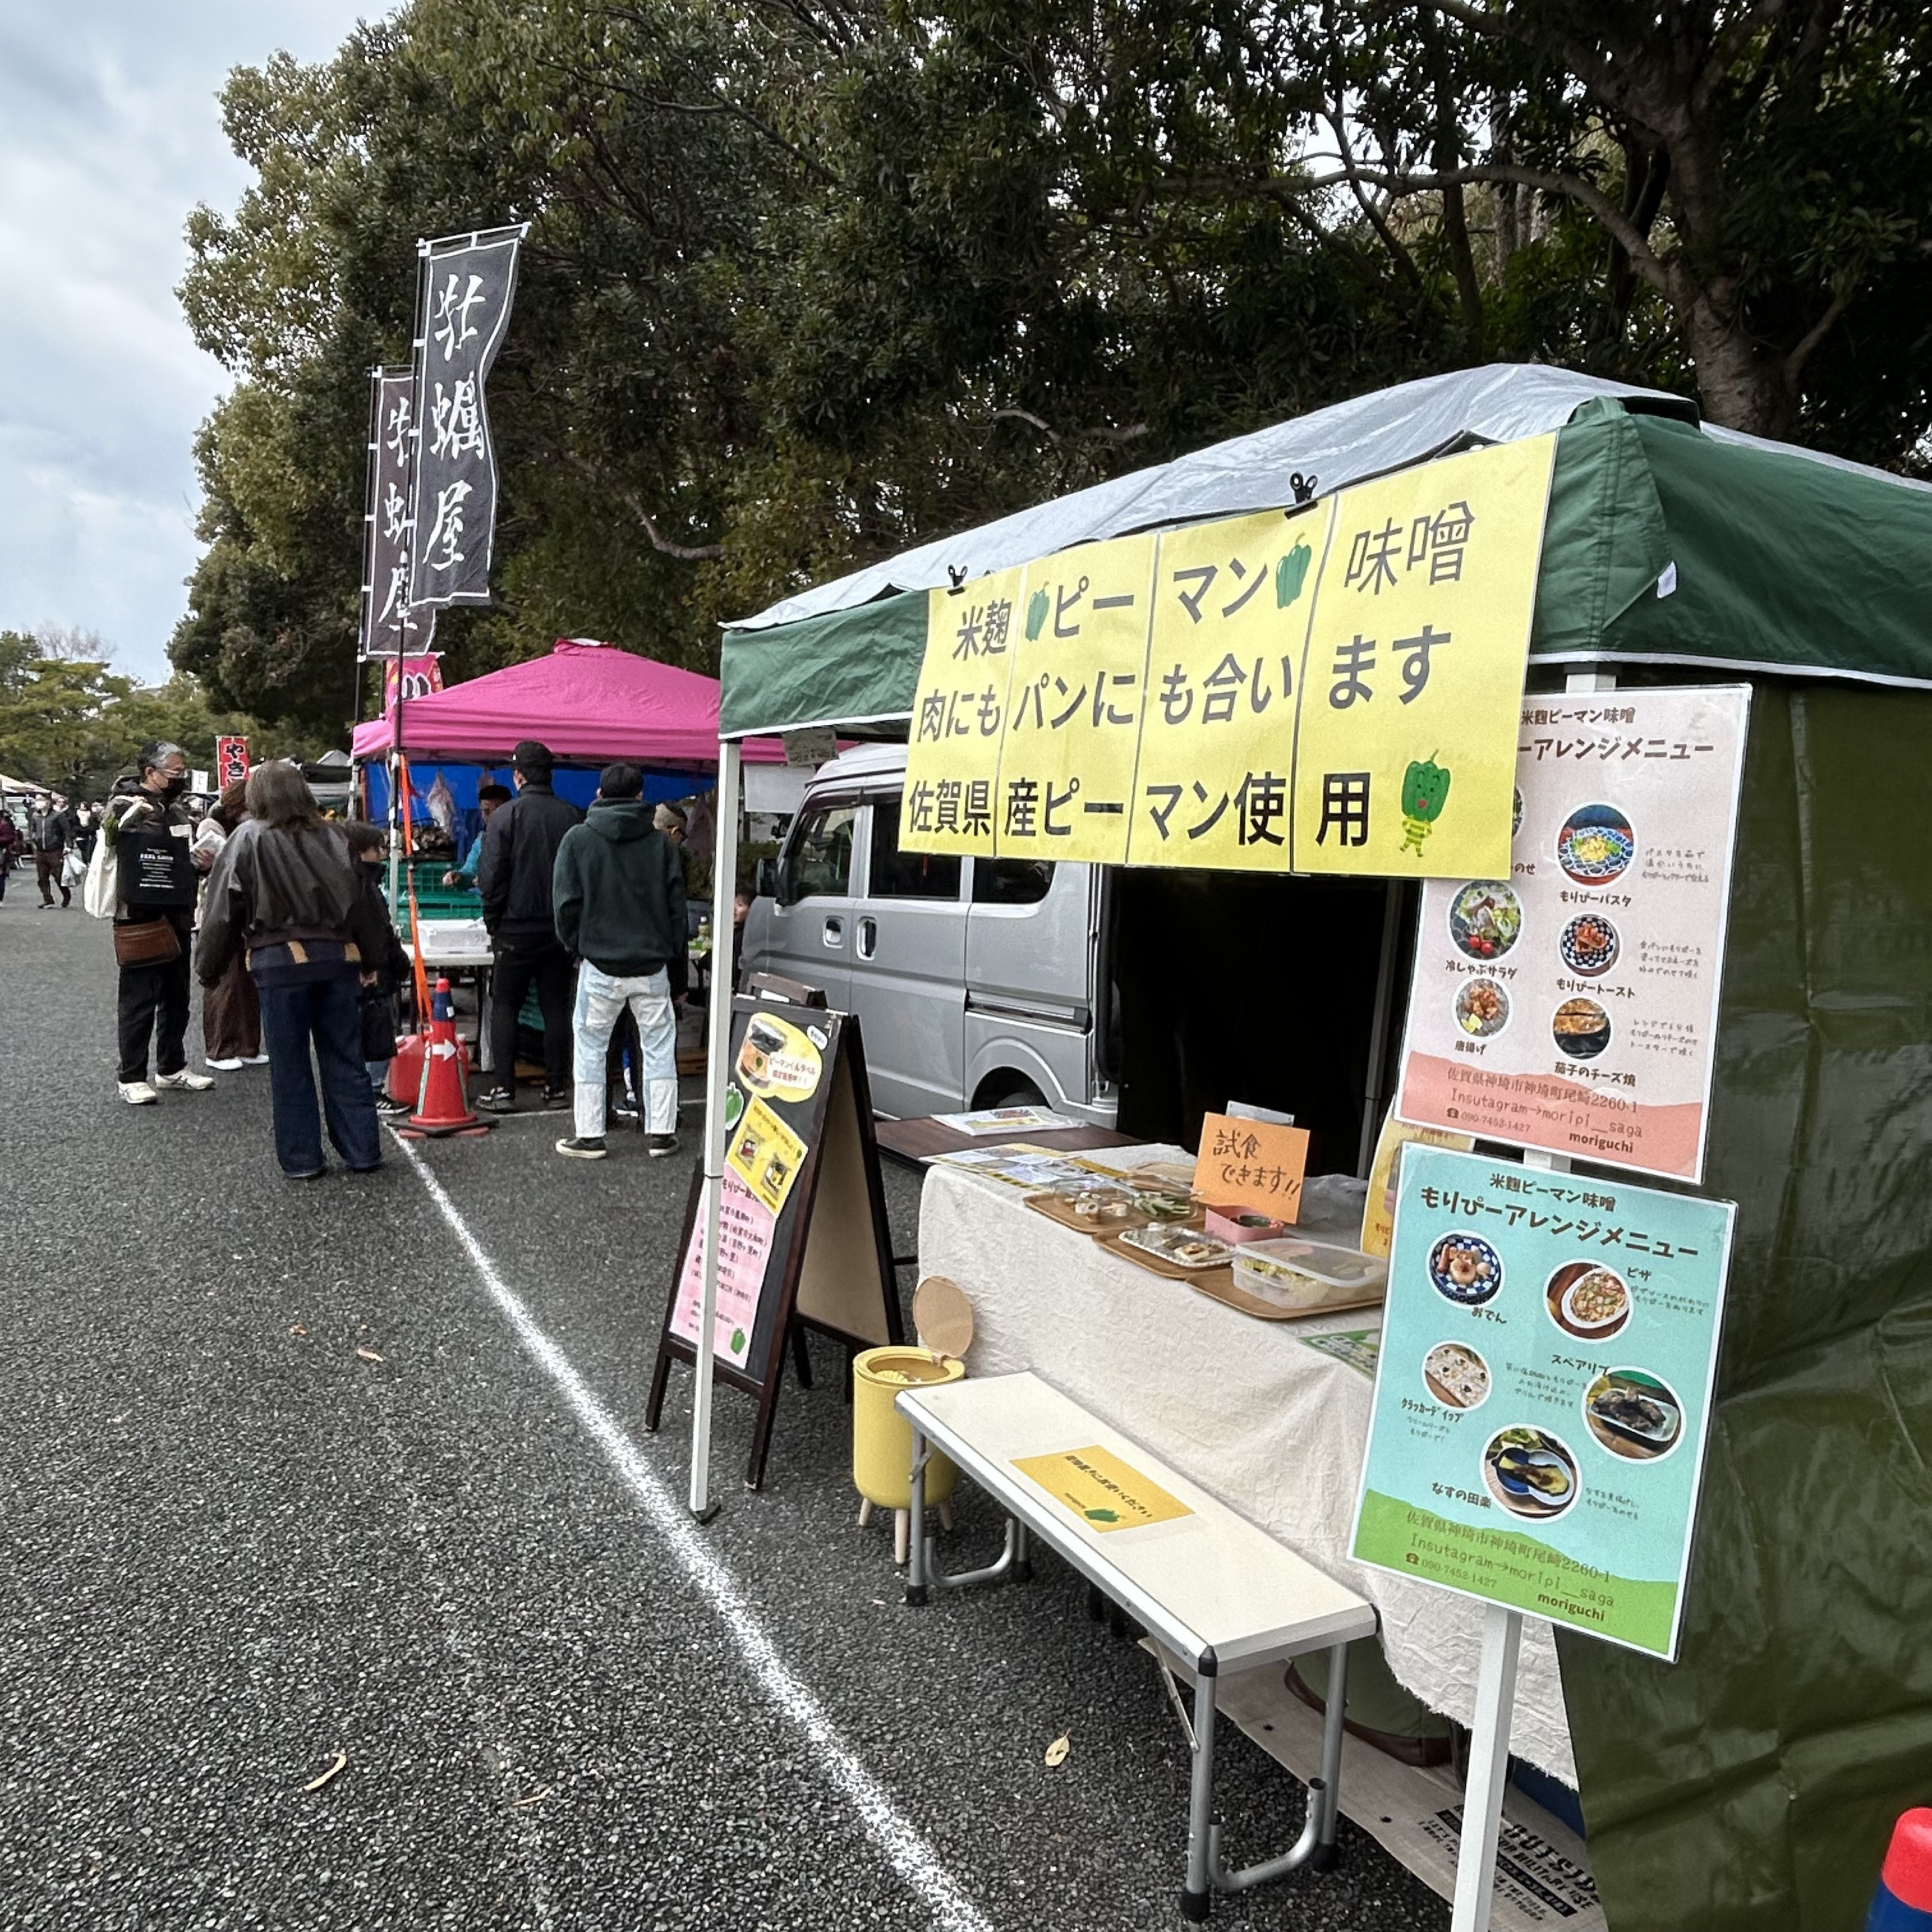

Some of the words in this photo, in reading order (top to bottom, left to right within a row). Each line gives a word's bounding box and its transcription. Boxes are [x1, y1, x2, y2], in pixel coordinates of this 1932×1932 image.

[952, 599, 1013, 662] 米麹
[1053, 556, 1268, 638] ピーマン
[1344, 500, 1475, 595] 味噌
[226, 743, 245, 783] やき
[1511, 863, 1536, 875] のせ
[1560, 891, 1632, 907] もりぴーパスタ
[1556, 978, 1636, 999] もりぴートースト
[1213, 1130, 1262, 1160] 試食
[1569, 1133, 1634, 1154] moriguchi
[1490, 1173, 1616, 1213] 米麹ピーマン味噌
[1421, 1186, 1699, 1259] もりぴーアレンジメニュー
[1471, 1306, 1508, 1324] おでん
[1432, 1482, 1492, 1508] なすの田楽
[1537, 1593, 1606, 1621] moriguchi
